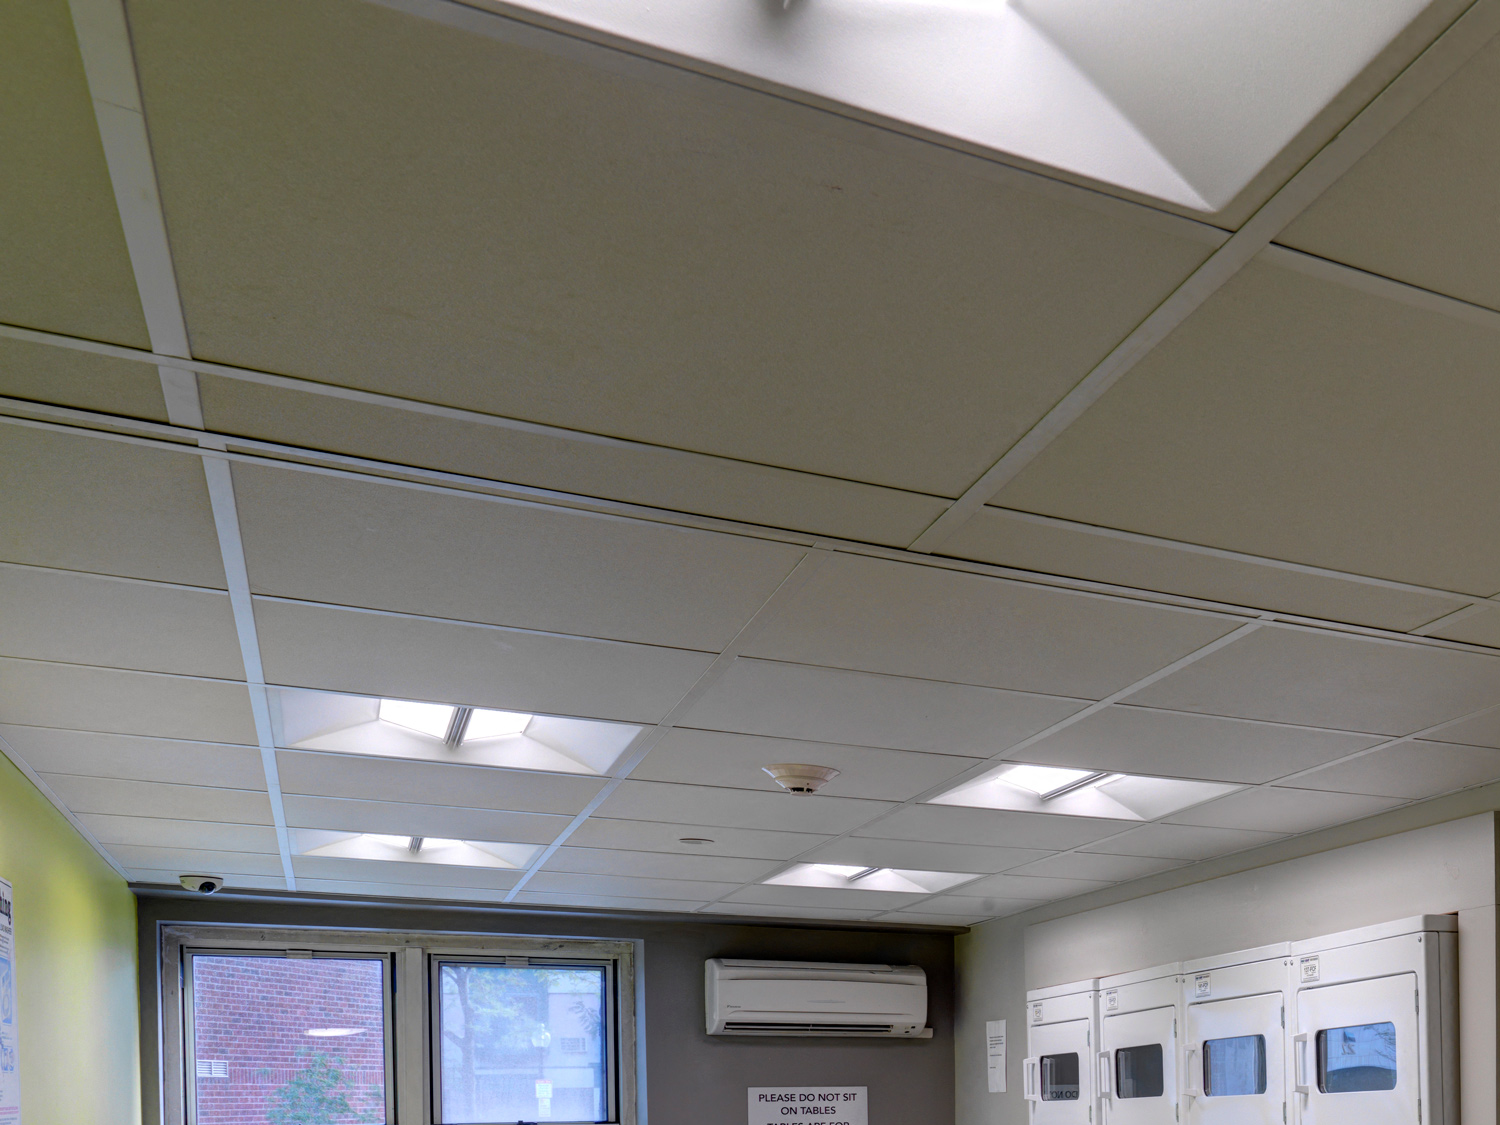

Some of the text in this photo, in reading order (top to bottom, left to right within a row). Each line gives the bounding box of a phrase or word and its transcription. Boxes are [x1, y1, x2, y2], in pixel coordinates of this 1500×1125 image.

[759, 1093, 857, 1102] PLEASE DO NOT SIT
[781, 1106, 836, 1115] ON TABLES
